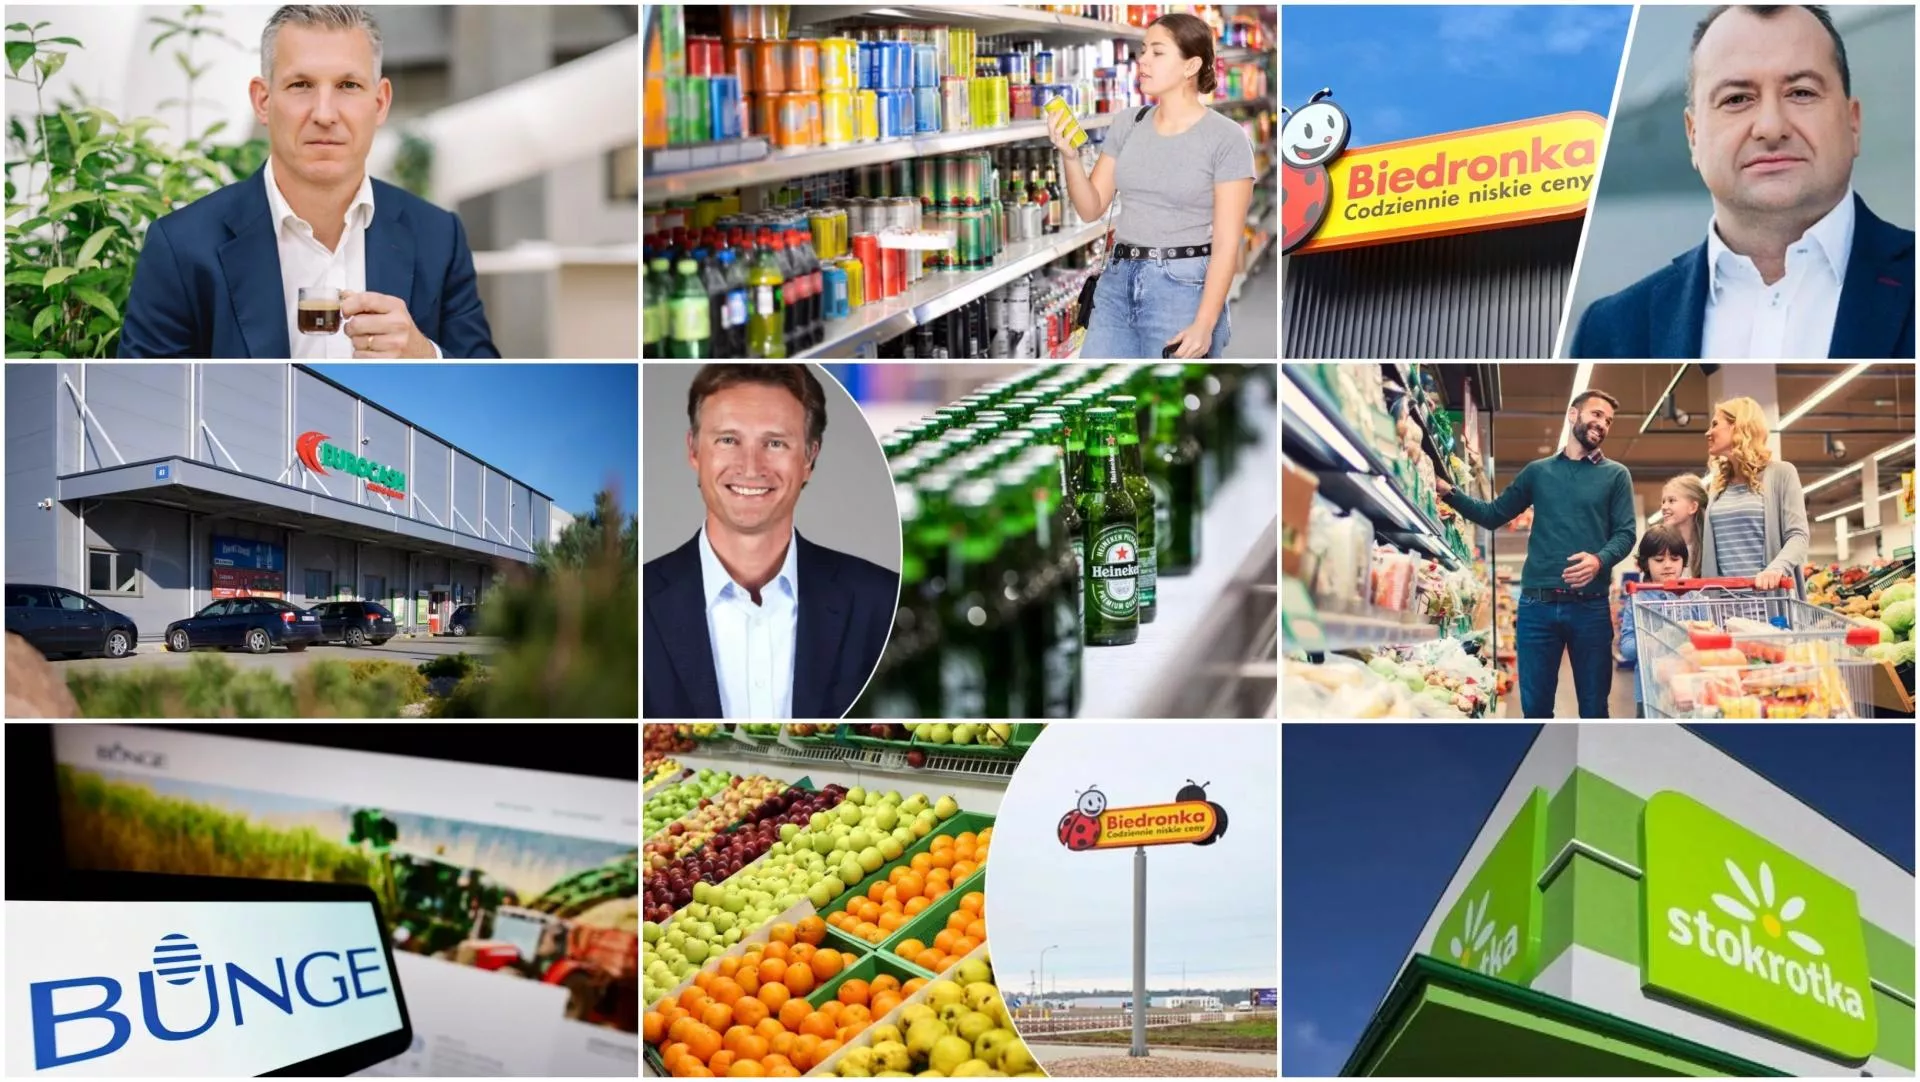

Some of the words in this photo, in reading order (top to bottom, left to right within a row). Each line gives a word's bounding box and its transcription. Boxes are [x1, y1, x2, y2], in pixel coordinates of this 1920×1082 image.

[1347, 136, 1595, 200] Biedronka
[1344, 189, 1460, 220] Codziennie
[1469, 179, 1532, 203] niskie
[1541, 173, 1594, 191] ceny
[1092, 564, 1139, 578] Heineke
[1107, 810, 1205, 830] Biedronka
[1107, 828, 1153, 839] Codziennie
[1156, 825, 1181, 834] niskie
[1184, 825, 1205, 833] ceny
[1667, 907, 1866, 1021] stokrotka
[30, 946, 388, 1071] BUNGE
